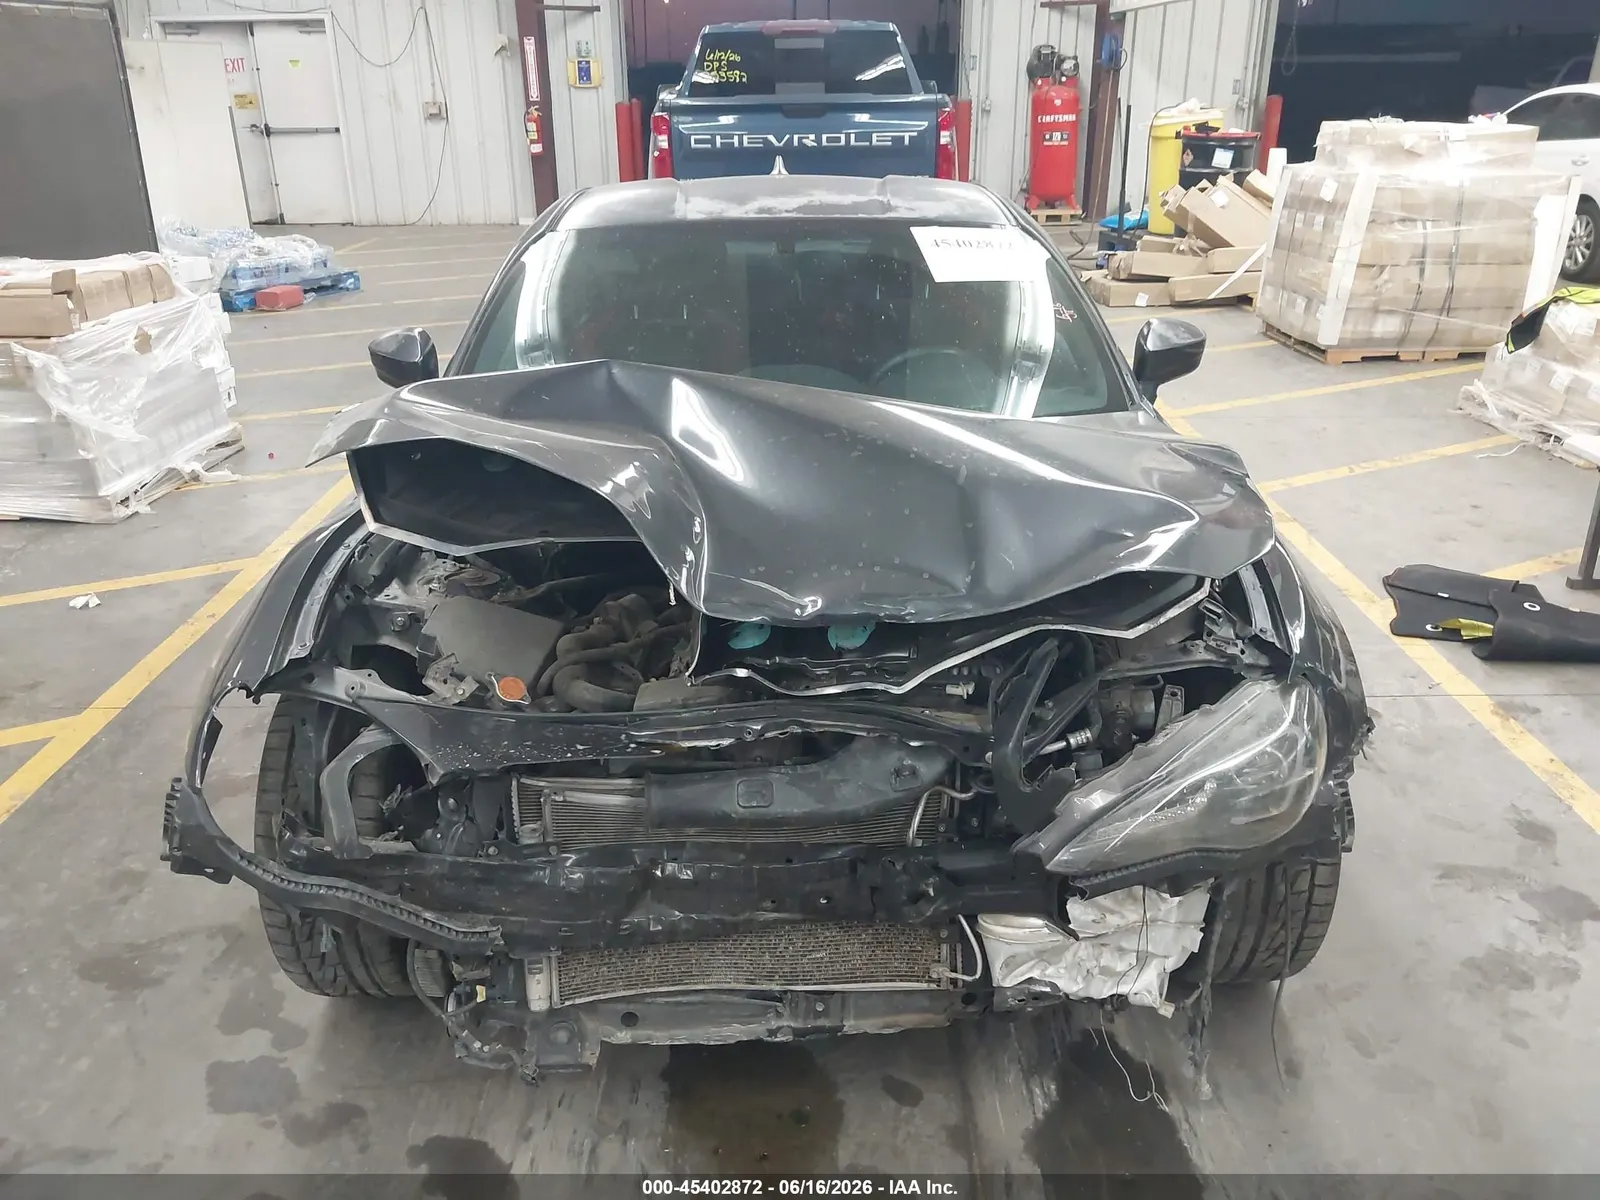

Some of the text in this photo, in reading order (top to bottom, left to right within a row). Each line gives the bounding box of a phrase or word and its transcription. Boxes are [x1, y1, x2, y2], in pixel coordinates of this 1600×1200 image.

[223, 57, 245, 73] EXIT
[703, 61, 728, 71] DPS
[690, 131, 918, 148] CHEVROLET
